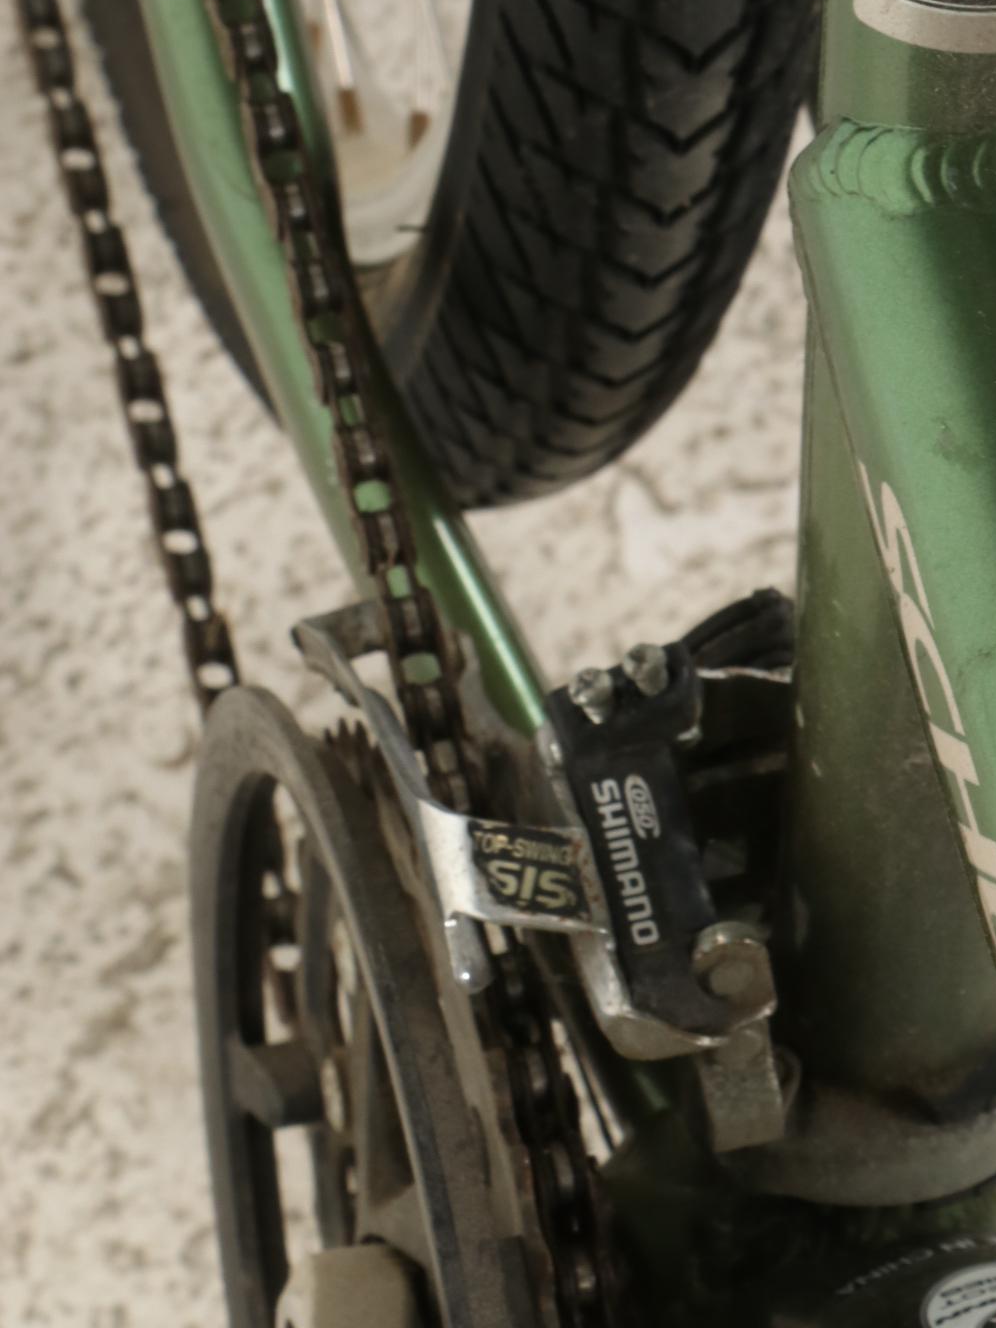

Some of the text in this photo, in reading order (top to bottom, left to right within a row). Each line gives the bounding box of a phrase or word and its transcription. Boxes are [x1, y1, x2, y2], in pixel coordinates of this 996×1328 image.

[473, 831, 572, 865] TOP-SWING
[591, 778, 660, 945] SHIMANO
[487, 860, 577, 908] SIS
